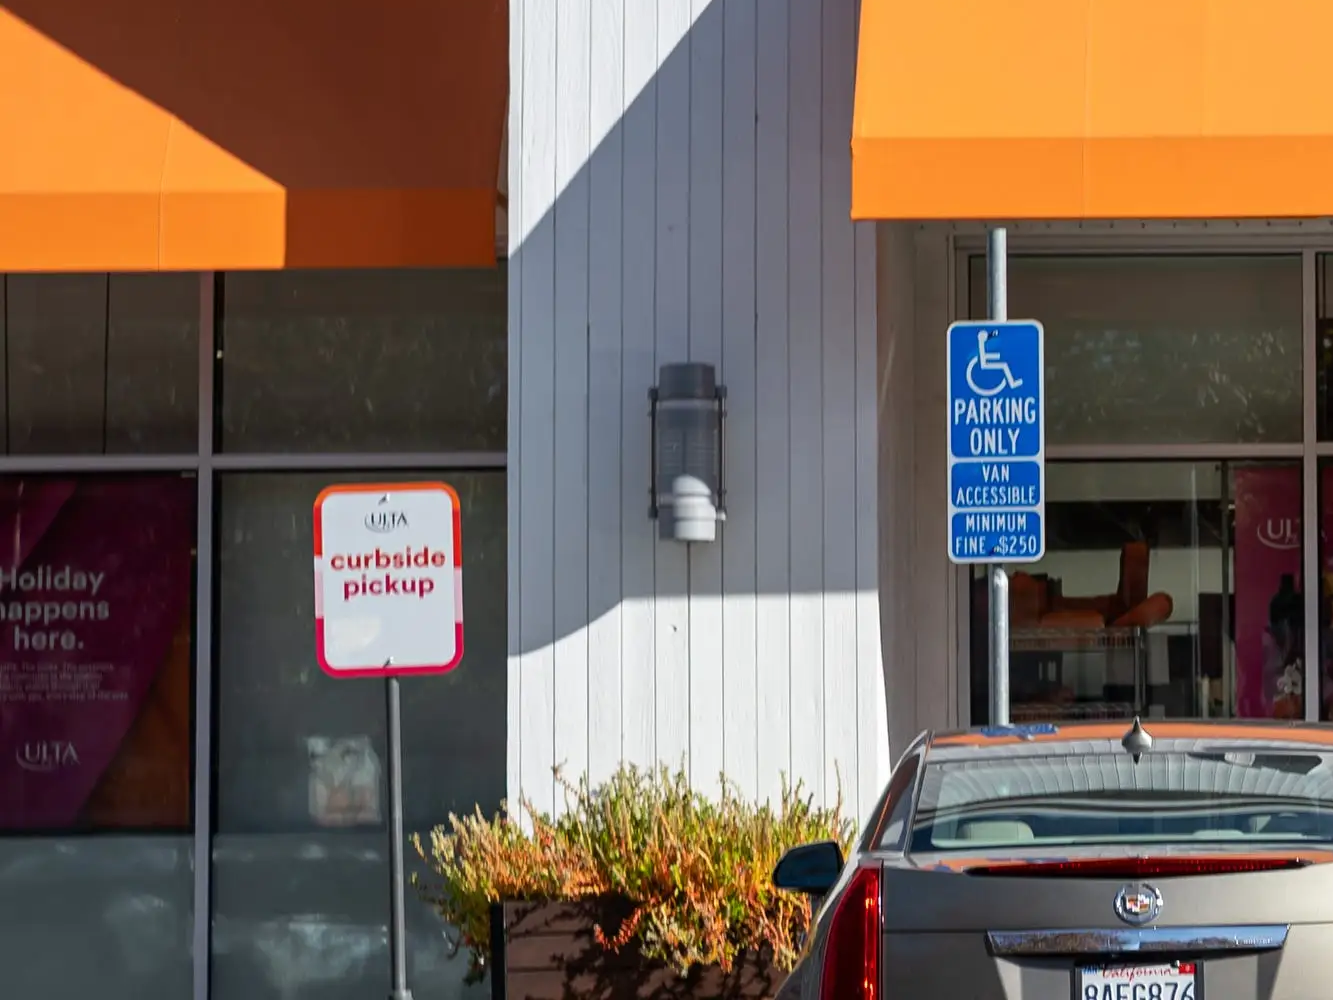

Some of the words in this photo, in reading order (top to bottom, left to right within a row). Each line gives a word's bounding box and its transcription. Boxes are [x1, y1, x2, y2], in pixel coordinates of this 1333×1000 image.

[954, 397, 1036, 426] PARKING
[969, 427, 1021, 456] ONLY
[981, 463, 1010, 483] VAN
[955, 484, 1036, 506] ACCESSIBLE
[370, 511, 410, 529] ULTA
[965, 512, 1027, 533] MINIMUM
[955, 535, 986, 555] FINE
[998, 534, 1037, 555] $250
[330, 545, 446, 571] curbside
[0, 564, 105, 597] Holiday
[343, 573, 435, 602] pickup
[13, 624, 85, 651] here.
[24, 740, 80, 765] ULTA
